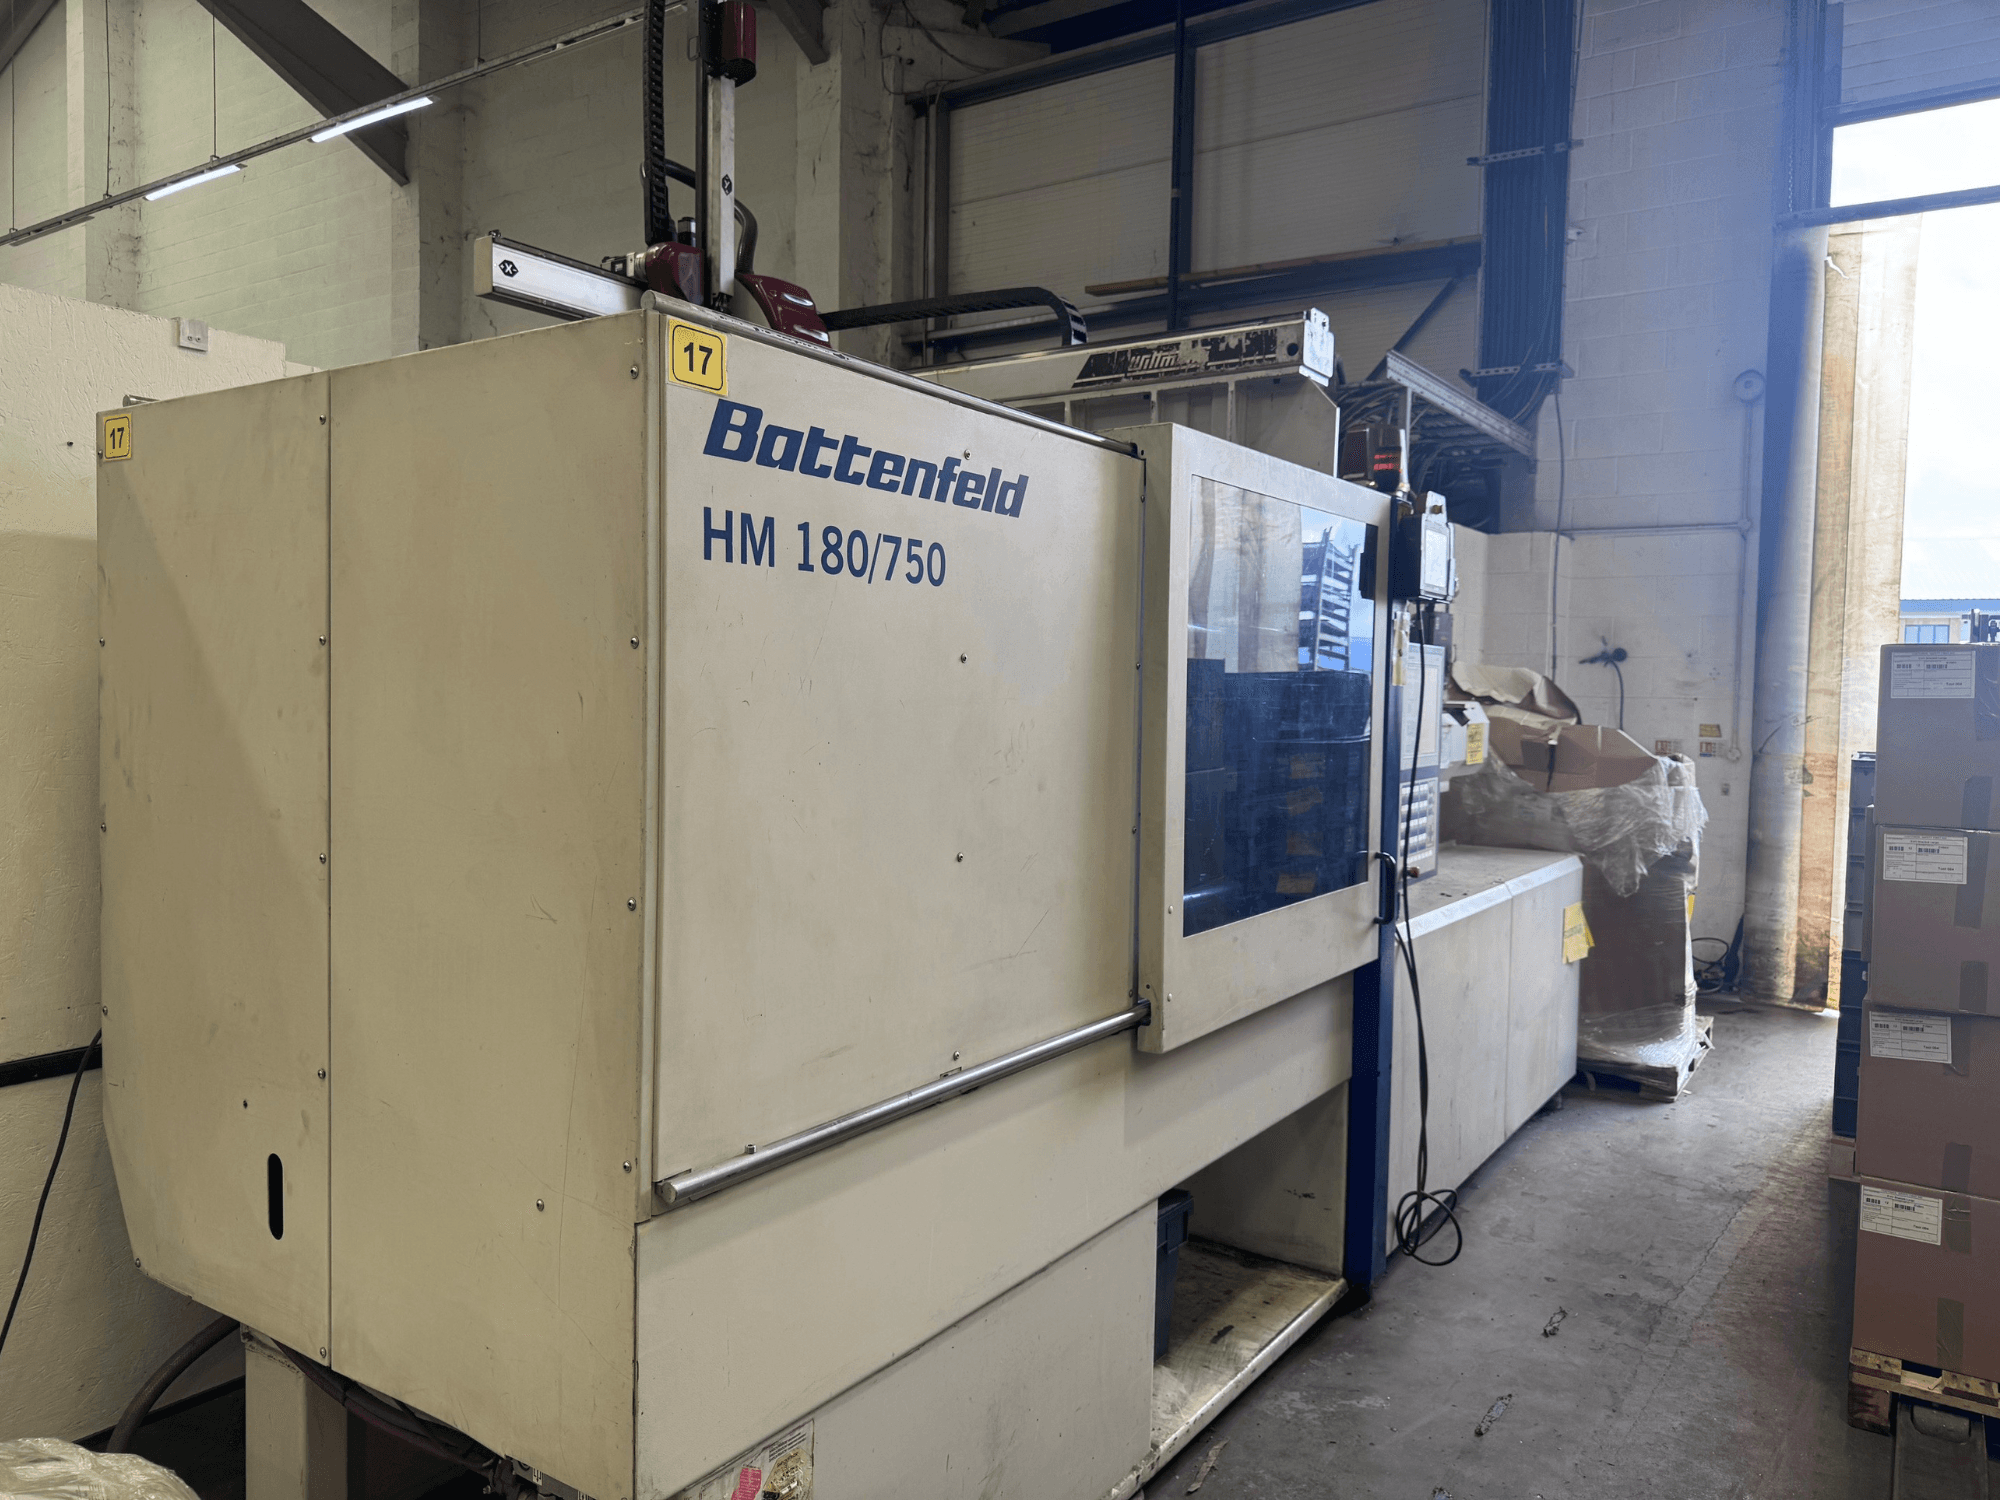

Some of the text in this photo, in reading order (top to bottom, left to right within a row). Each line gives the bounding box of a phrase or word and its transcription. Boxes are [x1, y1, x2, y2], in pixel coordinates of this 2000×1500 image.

[683, 342, 713, 375] 17
[110, 427, 125, 449] 17
[703, 398, 1029, 518] Battenfeld
[703, 507, 946, 587] HM 180/750
